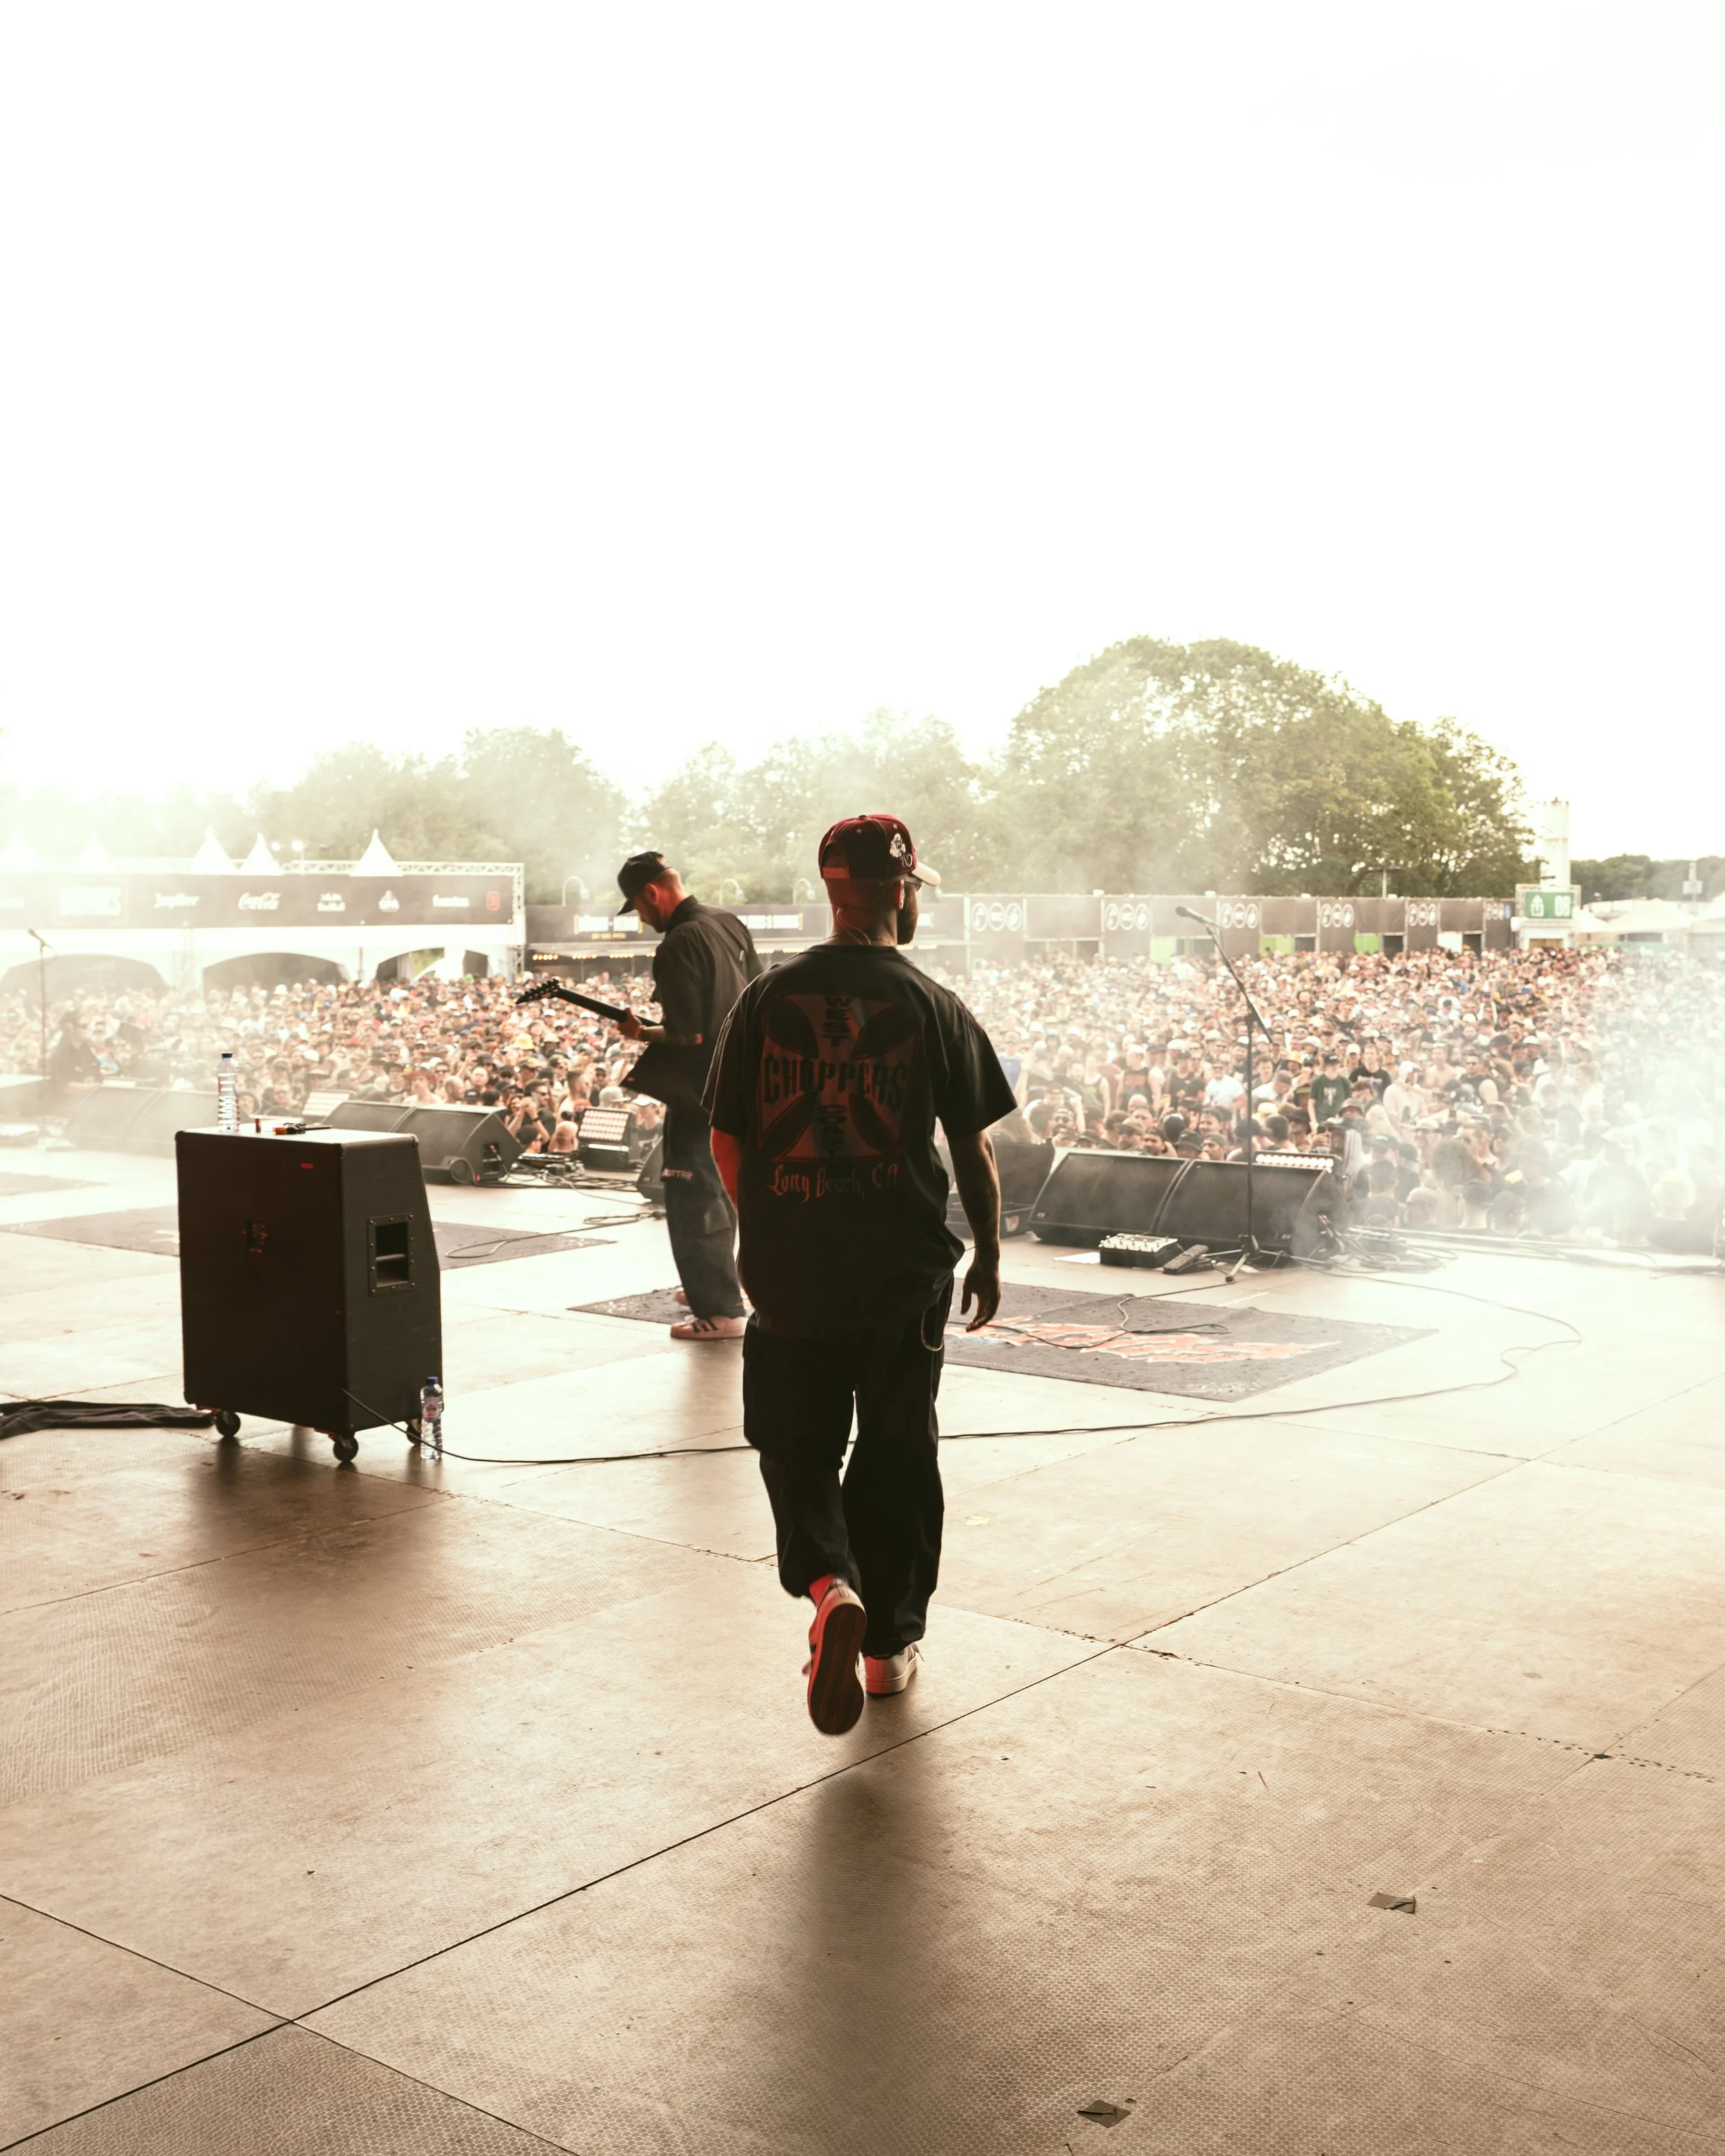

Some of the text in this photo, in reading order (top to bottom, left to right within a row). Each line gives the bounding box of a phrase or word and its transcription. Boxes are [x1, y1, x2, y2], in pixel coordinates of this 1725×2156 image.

[823, 996, 852, 1047] WEST
[763, 1054, 908, 1112] CHOPPERS
[768, 1165, 810, 1203] Long
[872, 1162, 899, 1189] CA
